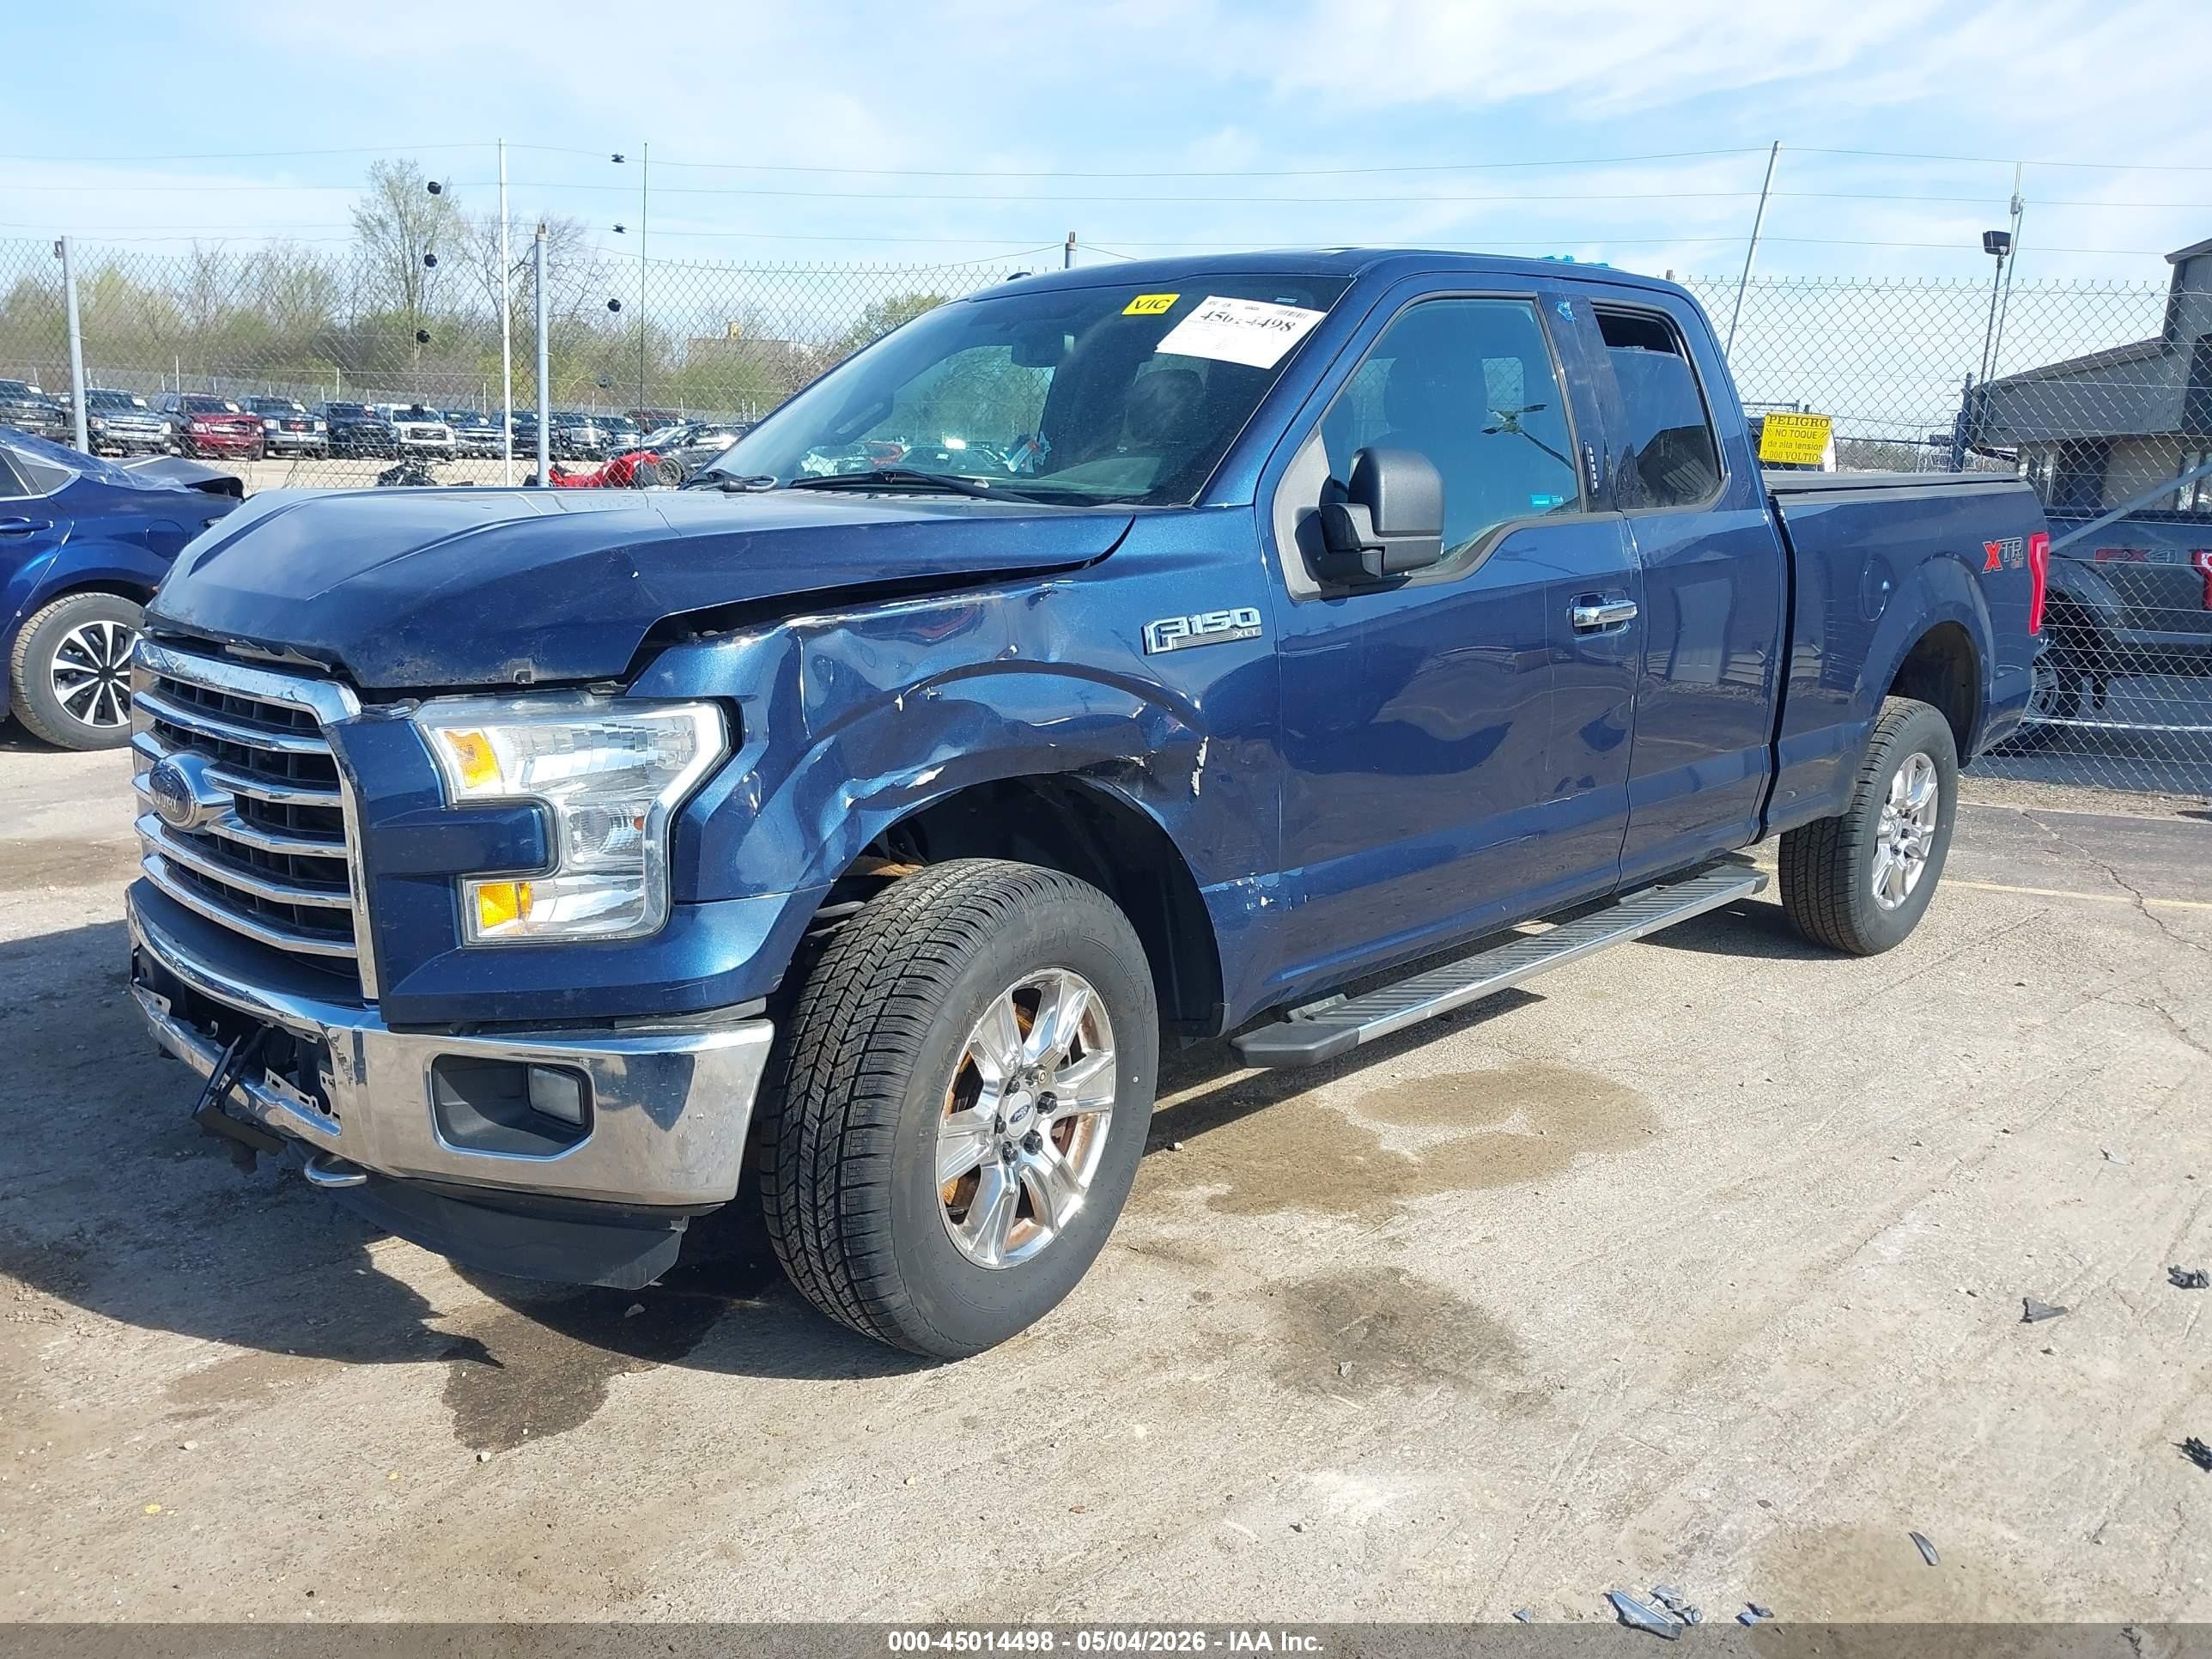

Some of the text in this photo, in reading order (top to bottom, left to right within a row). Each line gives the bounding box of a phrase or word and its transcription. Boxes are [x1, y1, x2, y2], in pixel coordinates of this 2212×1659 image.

[1134, 299, 1170, 310] VIC
[1769, 415, 1829, 428] PELIGRO
[1775, 428, 1818, 440] NO TOQUE
[1767, 439, 1778, 447] de
[1778, 440, 1793, 449] alta
[1981, 536, 2024, 574] XTR
[2094, 547, 2178, 565] FX4
[1234, 627, 1259, 639] XLT
